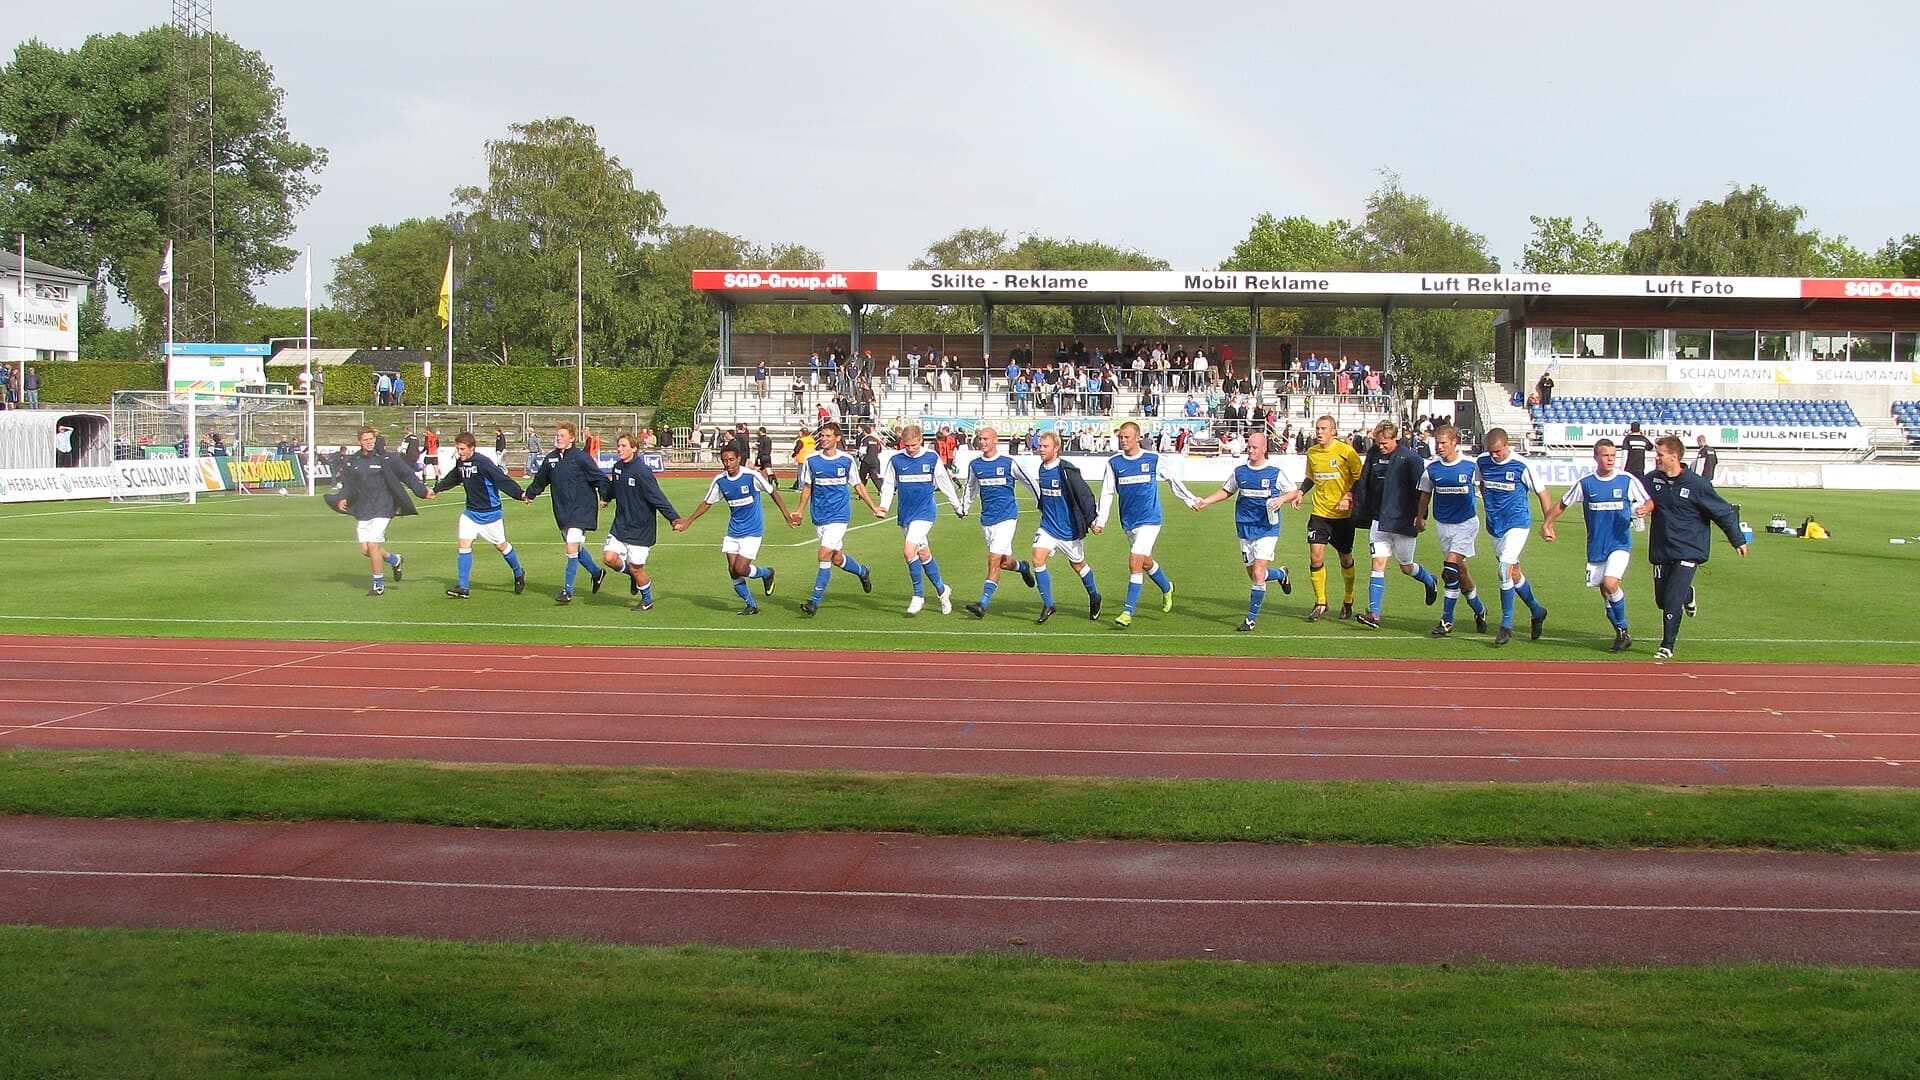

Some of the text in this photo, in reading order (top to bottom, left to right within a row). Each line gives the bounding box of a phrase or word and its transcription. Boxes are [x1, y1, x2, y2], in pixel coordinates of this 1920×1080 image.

[724, 274, 848, 290] SGD-Group.dk
[931, 274, 986, 288] Skilte
[1004, 274, 1088, 289] Reklame
[1184, 275, 1329, 290] Mobil Reklame
[1421, 277, 1551, 292] Luft Reklame
[1646, 280, 1734, 294] Luft Foto
[13, 311, 59, 327] SCHAUMANN
[1680, 367, 1772, 380] SCHAUMANN
[1816, 369, 1908, 381] SCHAUMANN
[912, 418, 957, 433] Bayer
[991, 419, 1036, 433] Bayer
[1071, 420, 1116, 434] Bayer
[1152, 421, 1197, 434] Bayer
[1587, 428, 1692, 437] JUUL&IELSEN
[1742, 431, 1847, 440] JUUL&NIELSEN
[121, 464, 203, 488] SCHAUMANN
[1536, 465, 1598, 482] HEM
[6, 477, 60, 491] HERBALIFE
[71, 475, 120, 489] HERBALIFE
